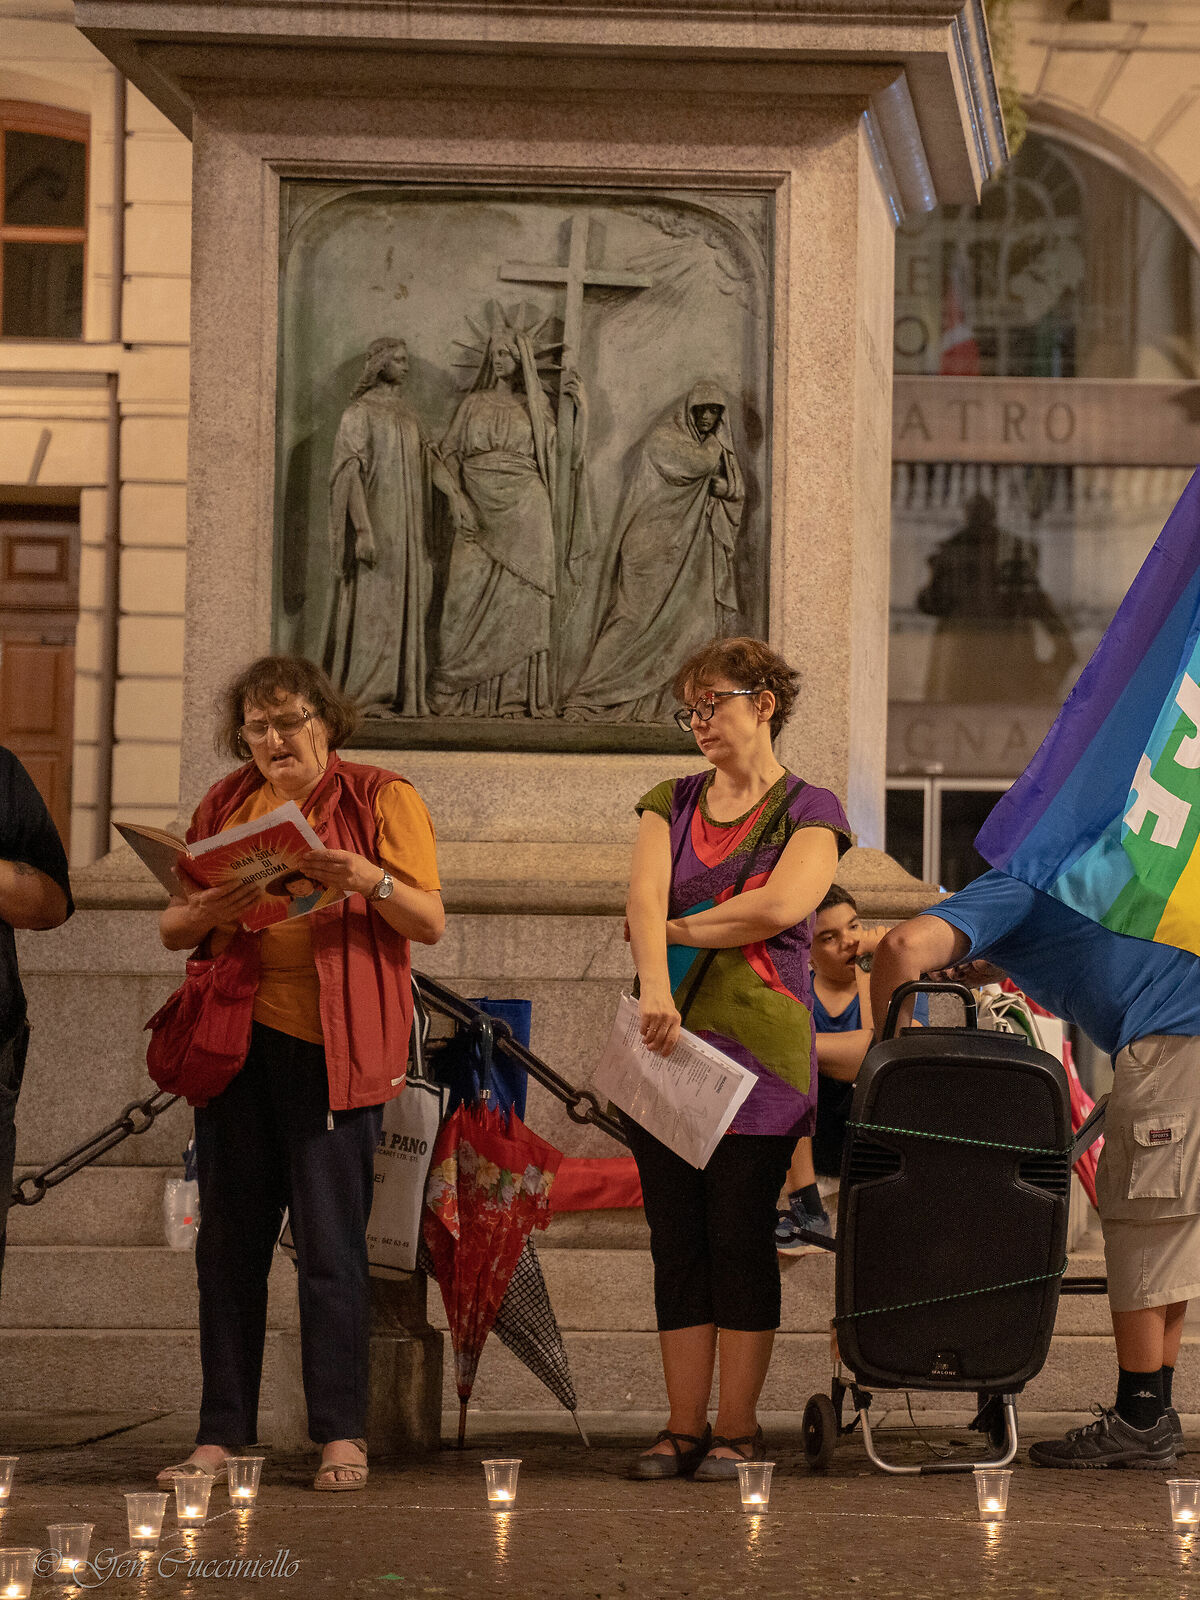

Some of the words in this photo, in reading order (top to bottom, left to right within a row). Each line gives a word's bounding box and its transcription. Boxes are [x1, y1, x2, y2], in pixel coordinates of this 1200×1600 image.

[255, 847, 280, 861] SOLE
[261, 859, 273, 868] DI
[241, 862, 288, 885] HIROSCIMA
[390, 1133, 428, 1156] PANO
